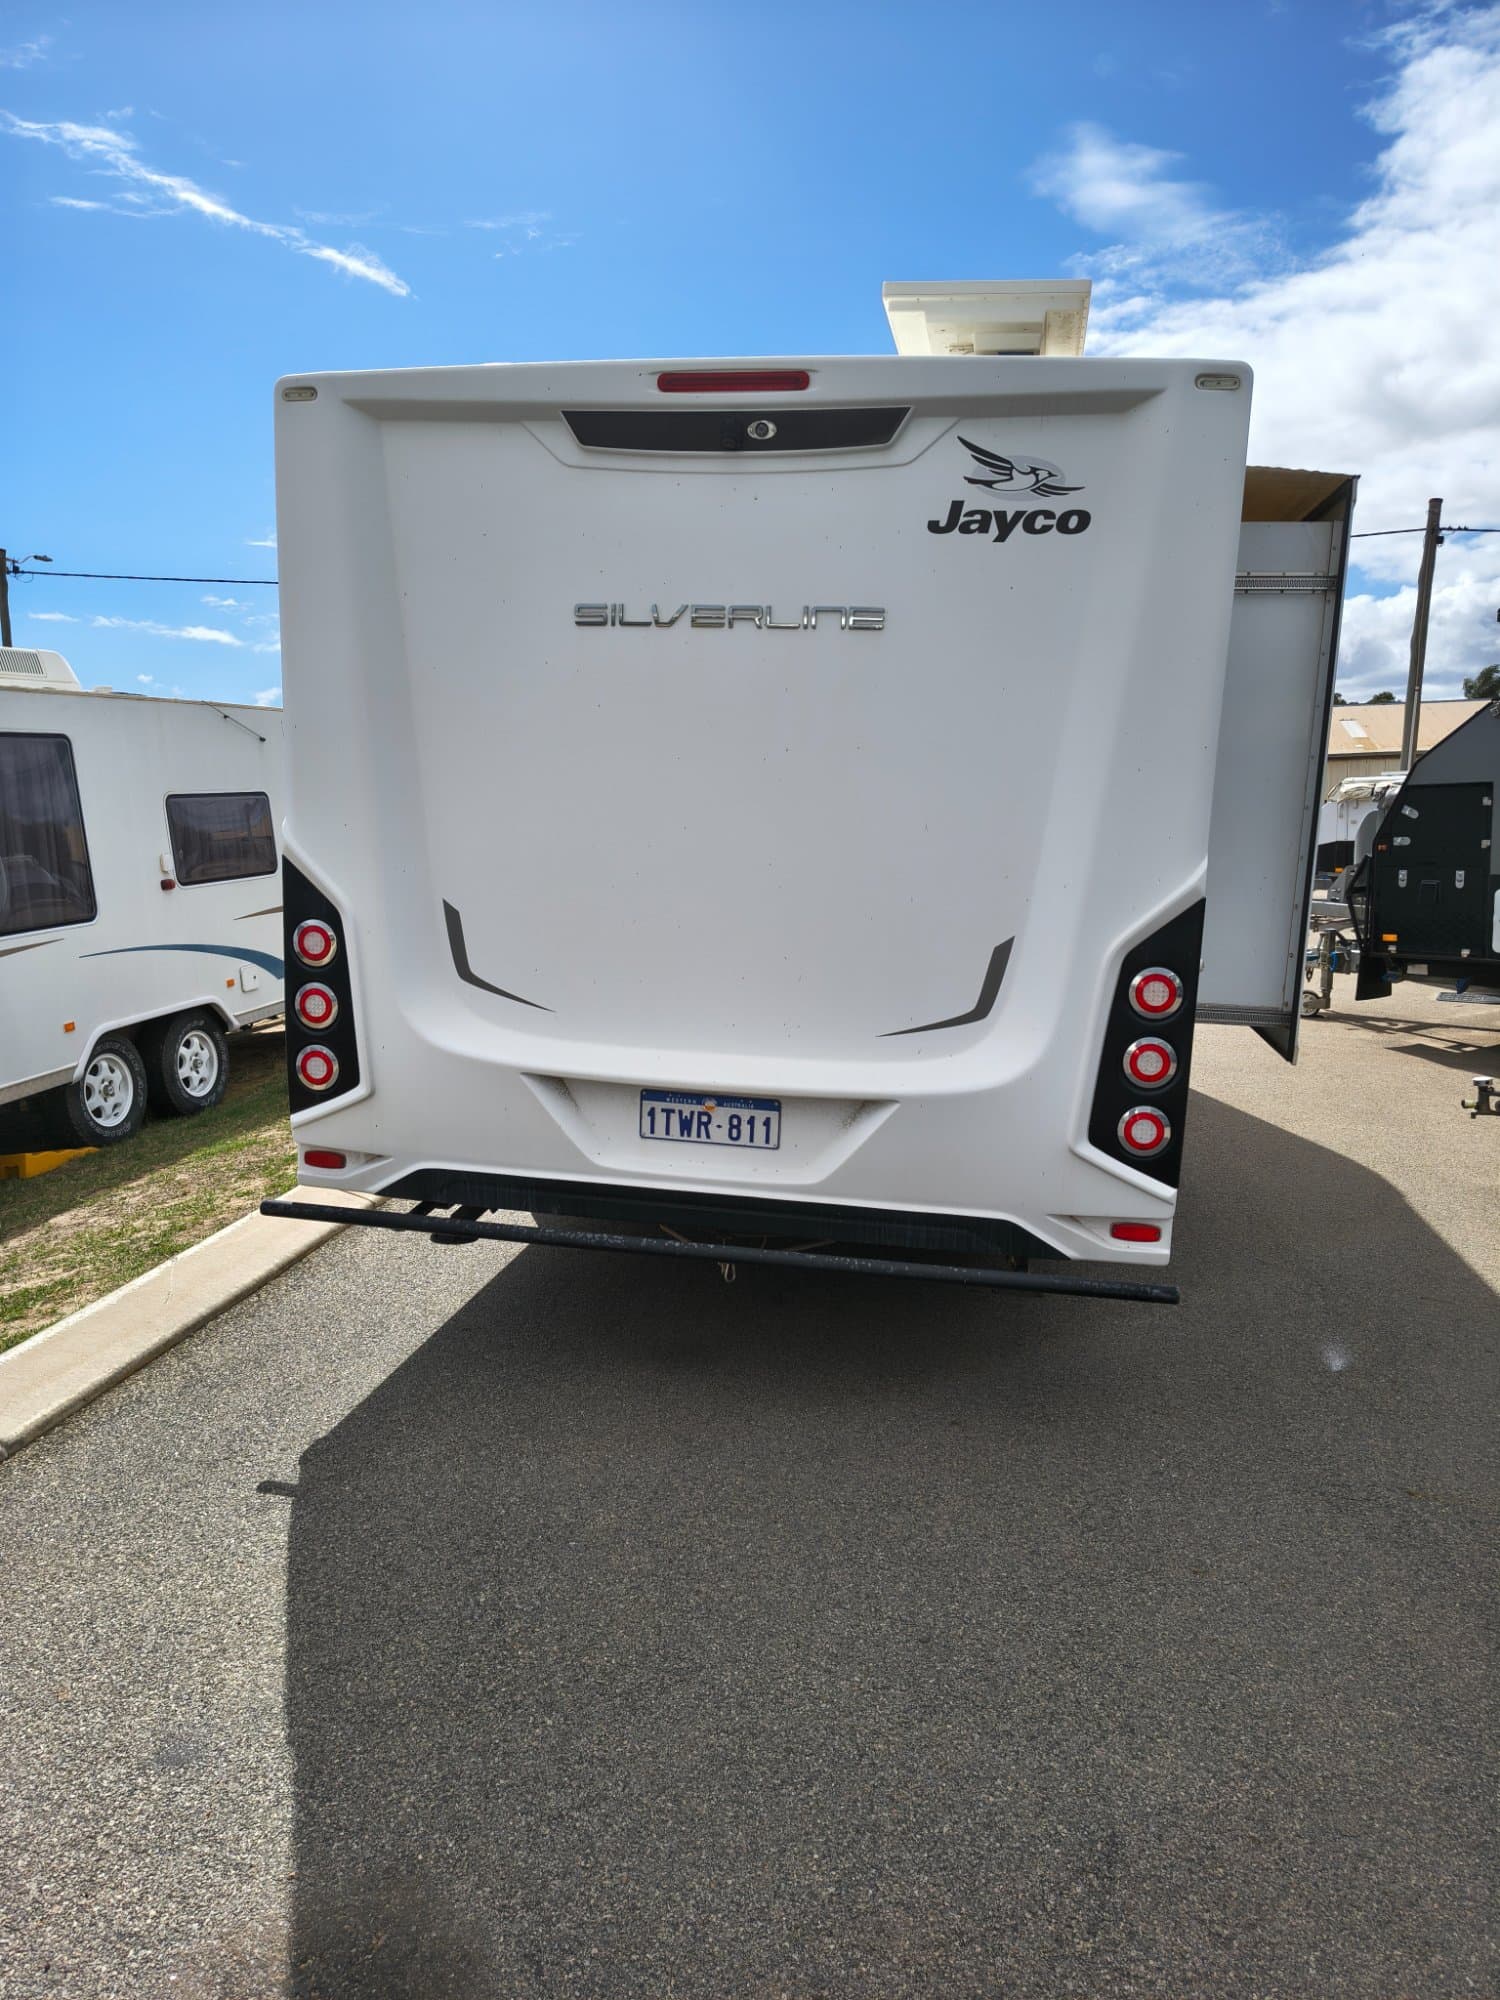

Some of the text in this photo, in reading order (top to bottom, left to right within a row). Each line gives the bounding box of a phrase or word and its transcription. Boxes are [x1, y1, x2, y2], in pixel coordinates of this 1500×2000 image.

[927, 500, 1092, 543] Jayco
[574, 603, 886, 630] SILVERLINE
[723, 1101, 754, 1109] AUSTRALIA
[647, 1106, 771, 1145] 1TWR-811
